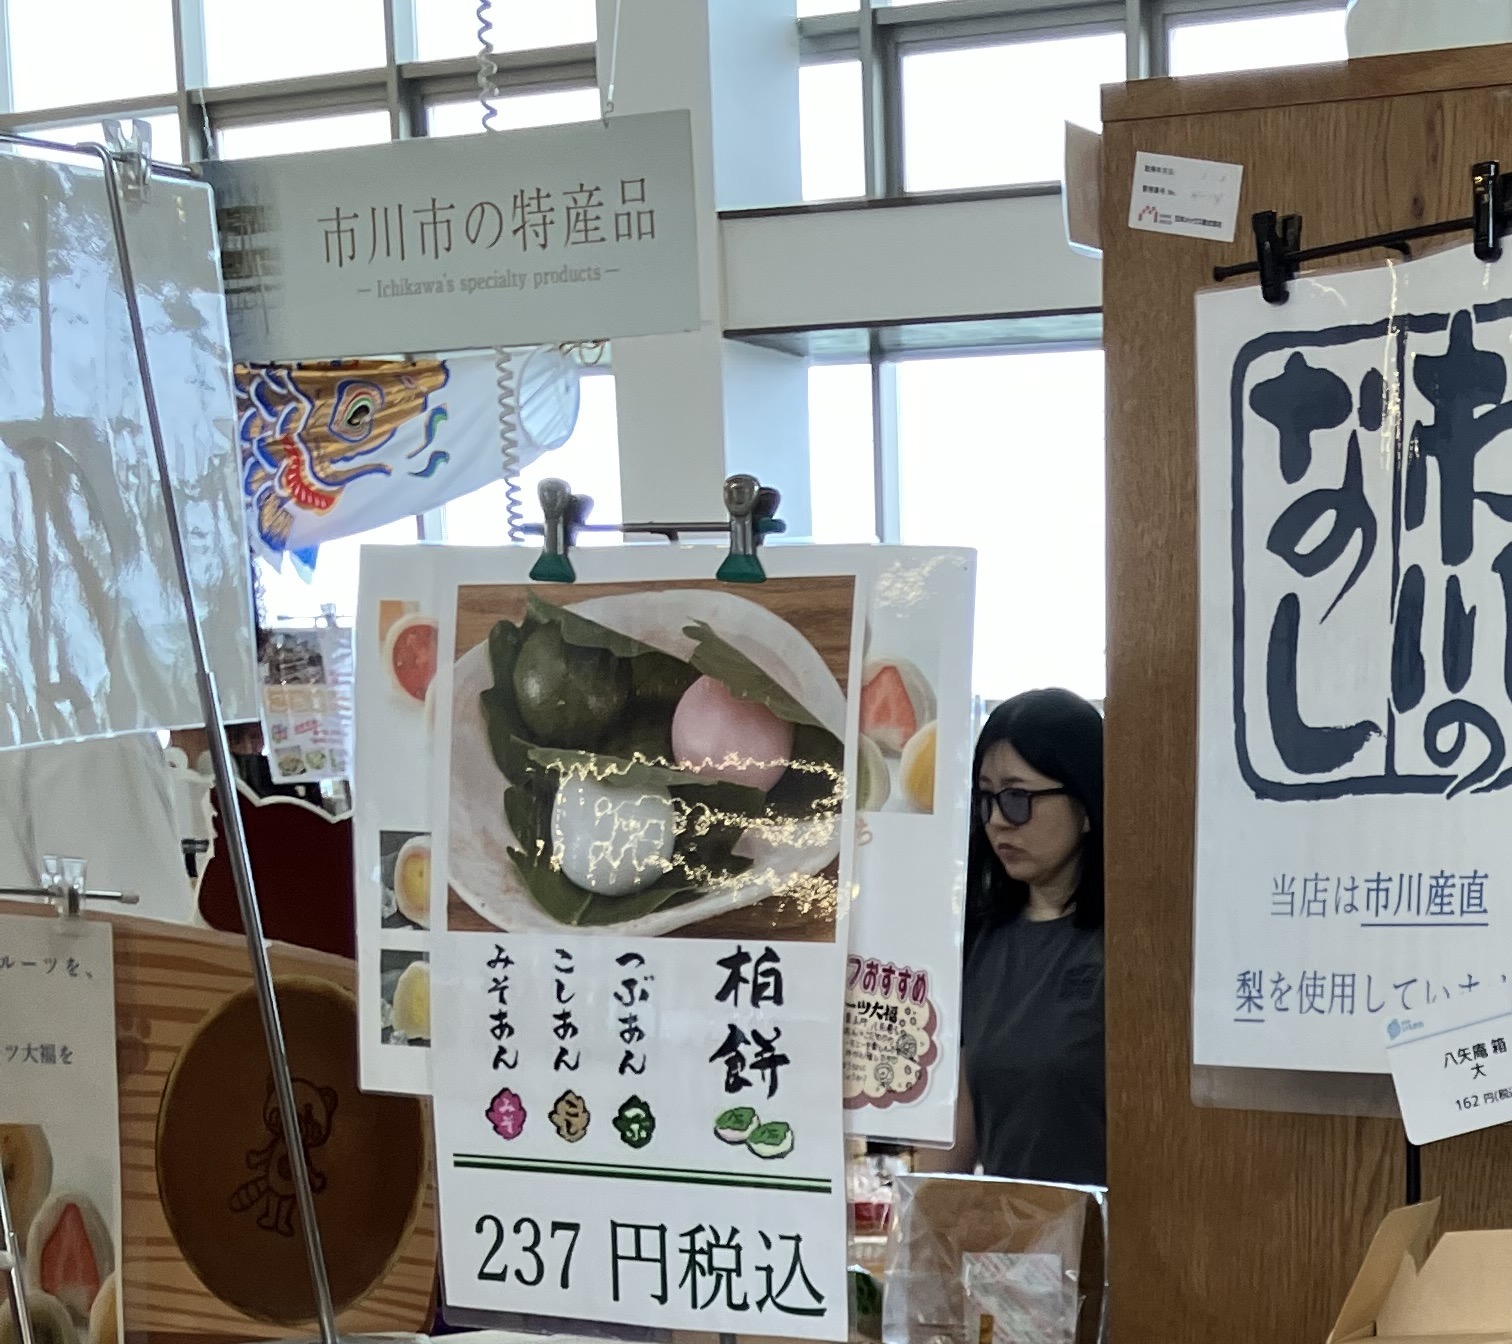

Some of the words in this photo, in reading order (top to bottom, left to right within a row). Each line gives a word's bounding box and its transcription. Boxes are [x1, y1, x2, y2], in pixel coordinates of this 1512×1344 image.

[317, 178, 656, 268] 市川市の特産品
[377, 272, 455, 298] Ichikawa's
[460, 269, 526, 294] specialty
[534, 264, 601, 290] products
[1270, 870, 1489, 919] 当店は市川産直
[485, 944, 519, 1071] みそあん
[551, 948, 581, 1072] こしあん
[613, 951, 655, 1076] つぶあん
[708, 944, 791, 1099] 柏餅
[1492, 1037, 1508, 1054] 箱
[1455, 1094, 1480, 1111] 162
[1471, 1063, 1488, 1080] 大
[474, 1213, 581, 1291] 237
[610, 1218, 827, 1317] 円税込
